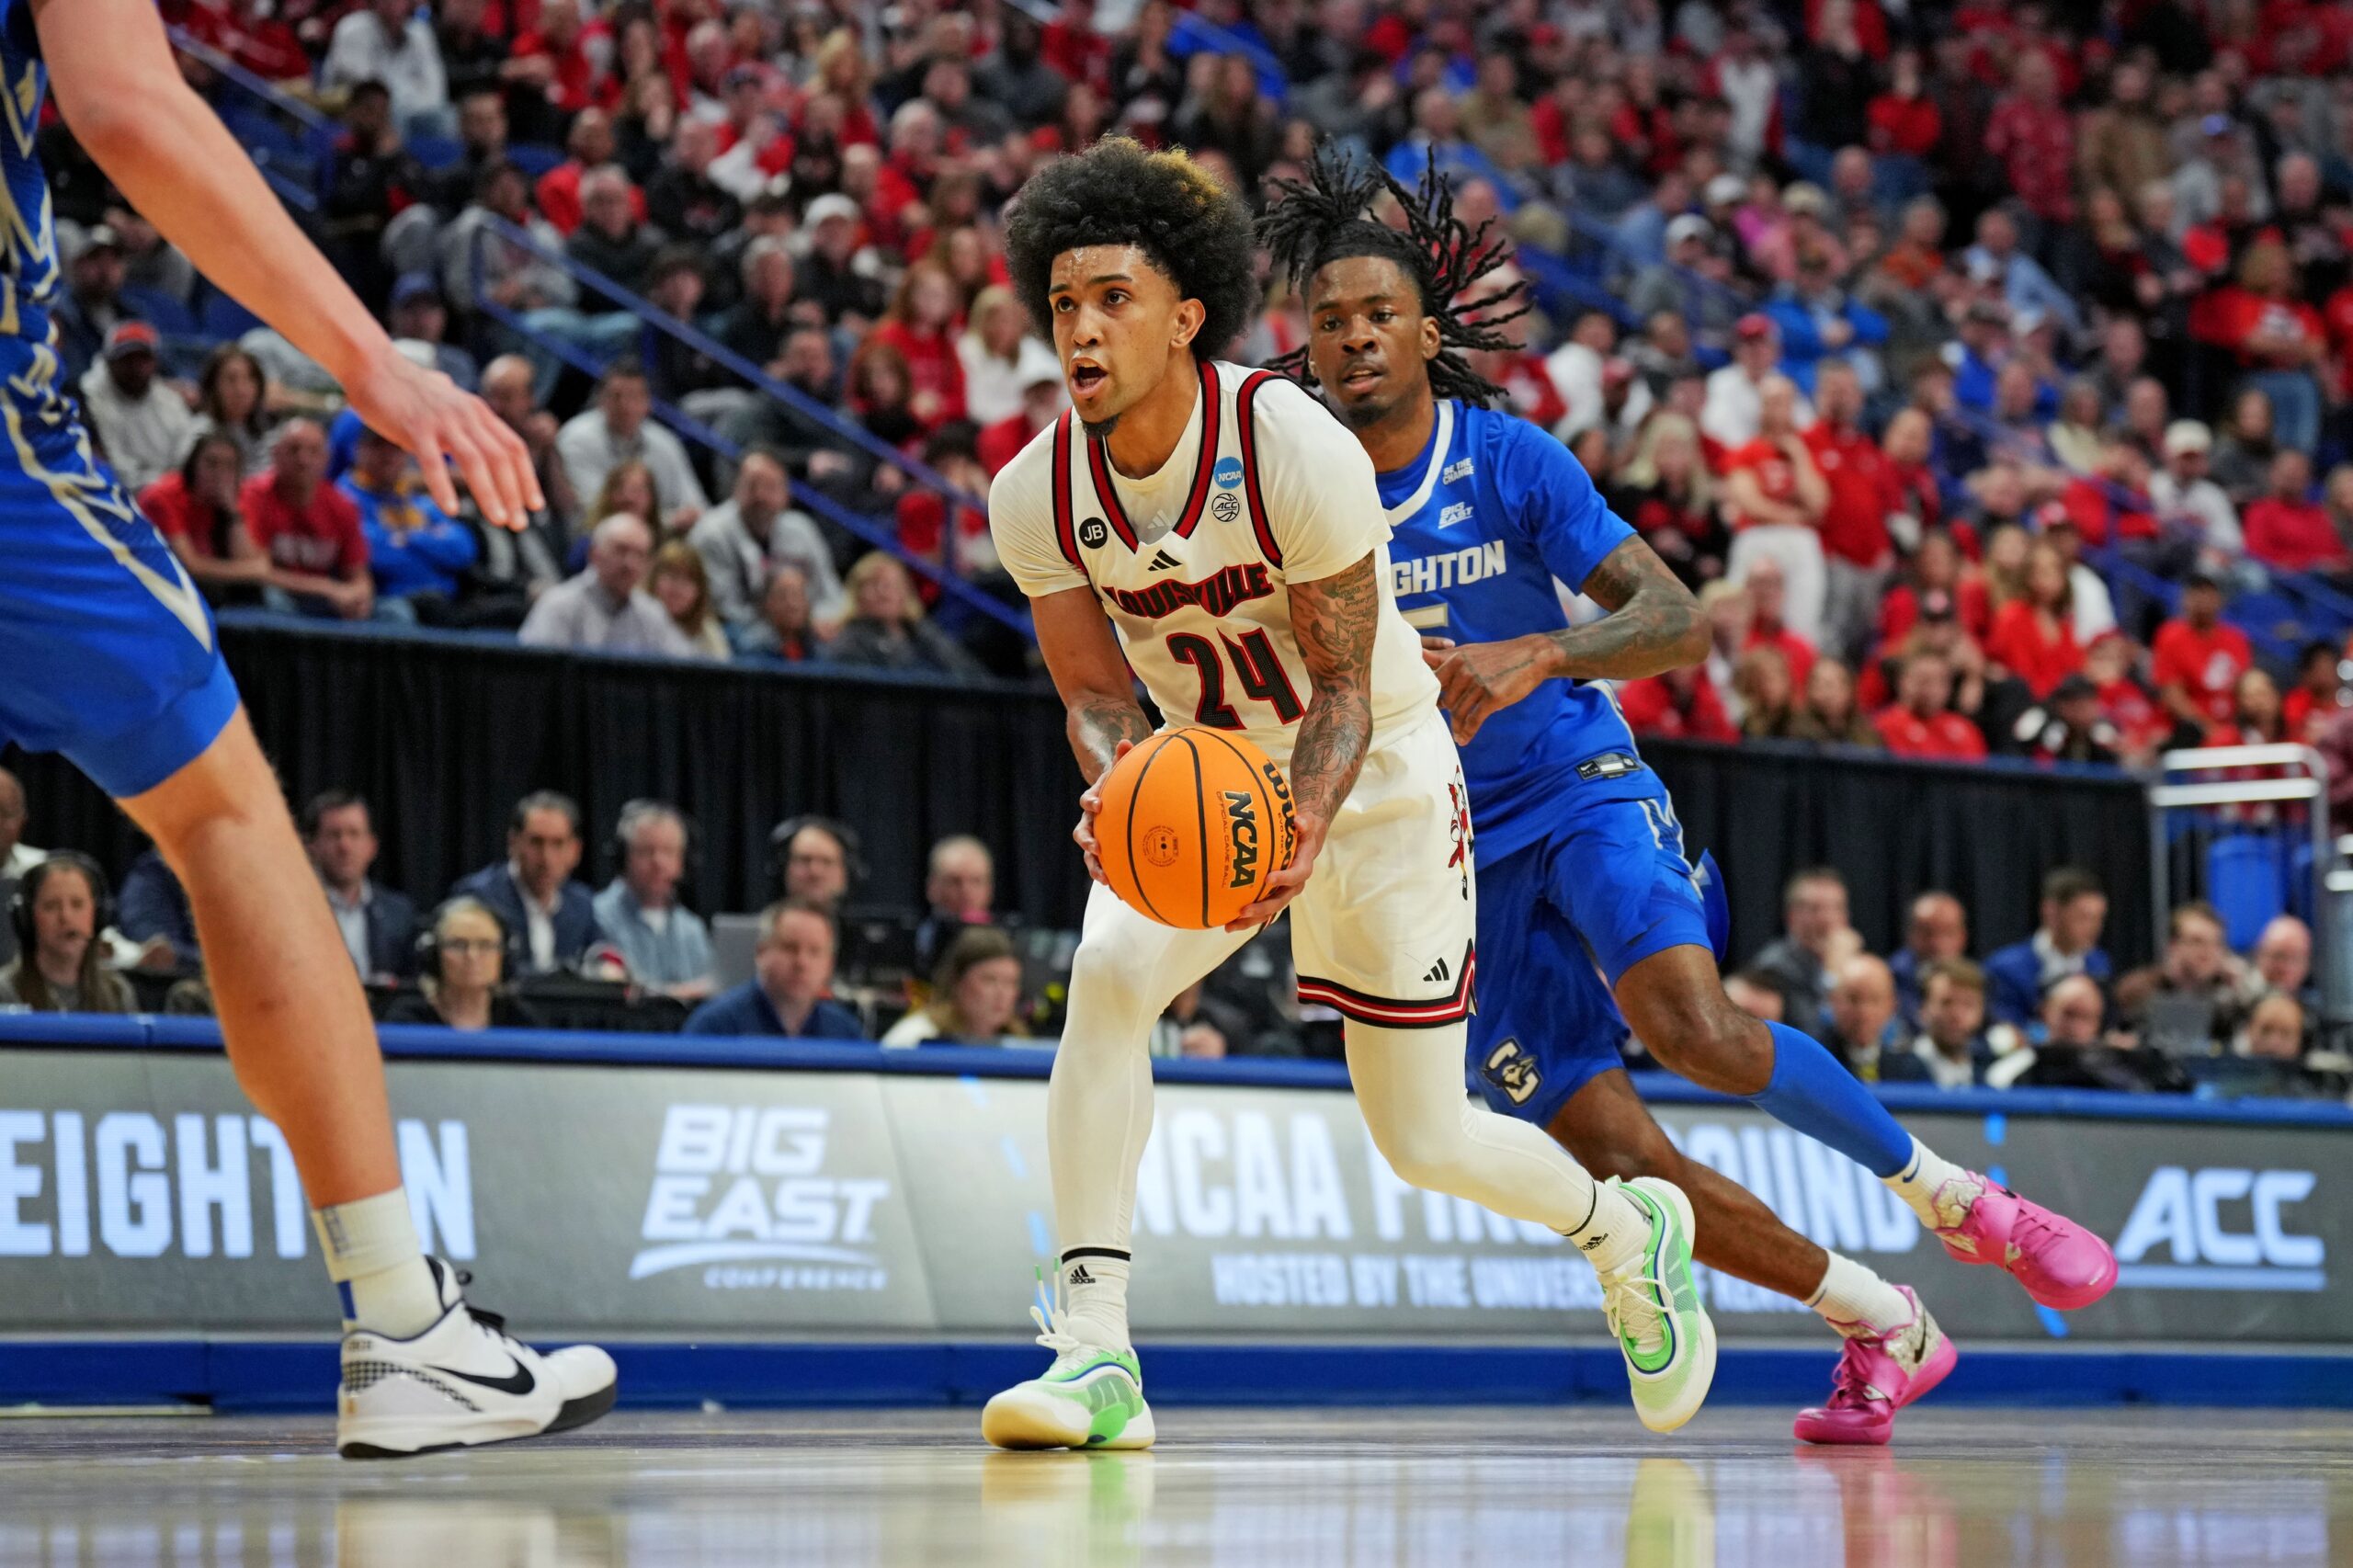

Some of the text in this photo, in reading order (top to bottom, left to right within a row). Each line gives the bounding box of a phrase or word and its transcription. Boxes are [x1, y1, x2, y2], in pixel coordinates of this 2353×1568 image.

[1215, 502, 1238, 510] ACC
[1219, 471, 1242, 483] NCAA
[1440, 502, 1465, 517] BIG
[1085, 524, 1104, 540] JB
[1439, 506, 1473, 526] EAST
[1166, 627, 1305, 731] 24
[1216, 790, 1228, 834] OFFICIAL
[1222, 865, 1230, 888] BALL
[1223, 790, 1257, 889] NCAA
[655, 1105, 830, 1176] BIG
[0, 1110, 476, 1259] EIGHTN
[641, 1175, 890, 1244] EAST
[2114, 1165, 2326, 1267] ACC
